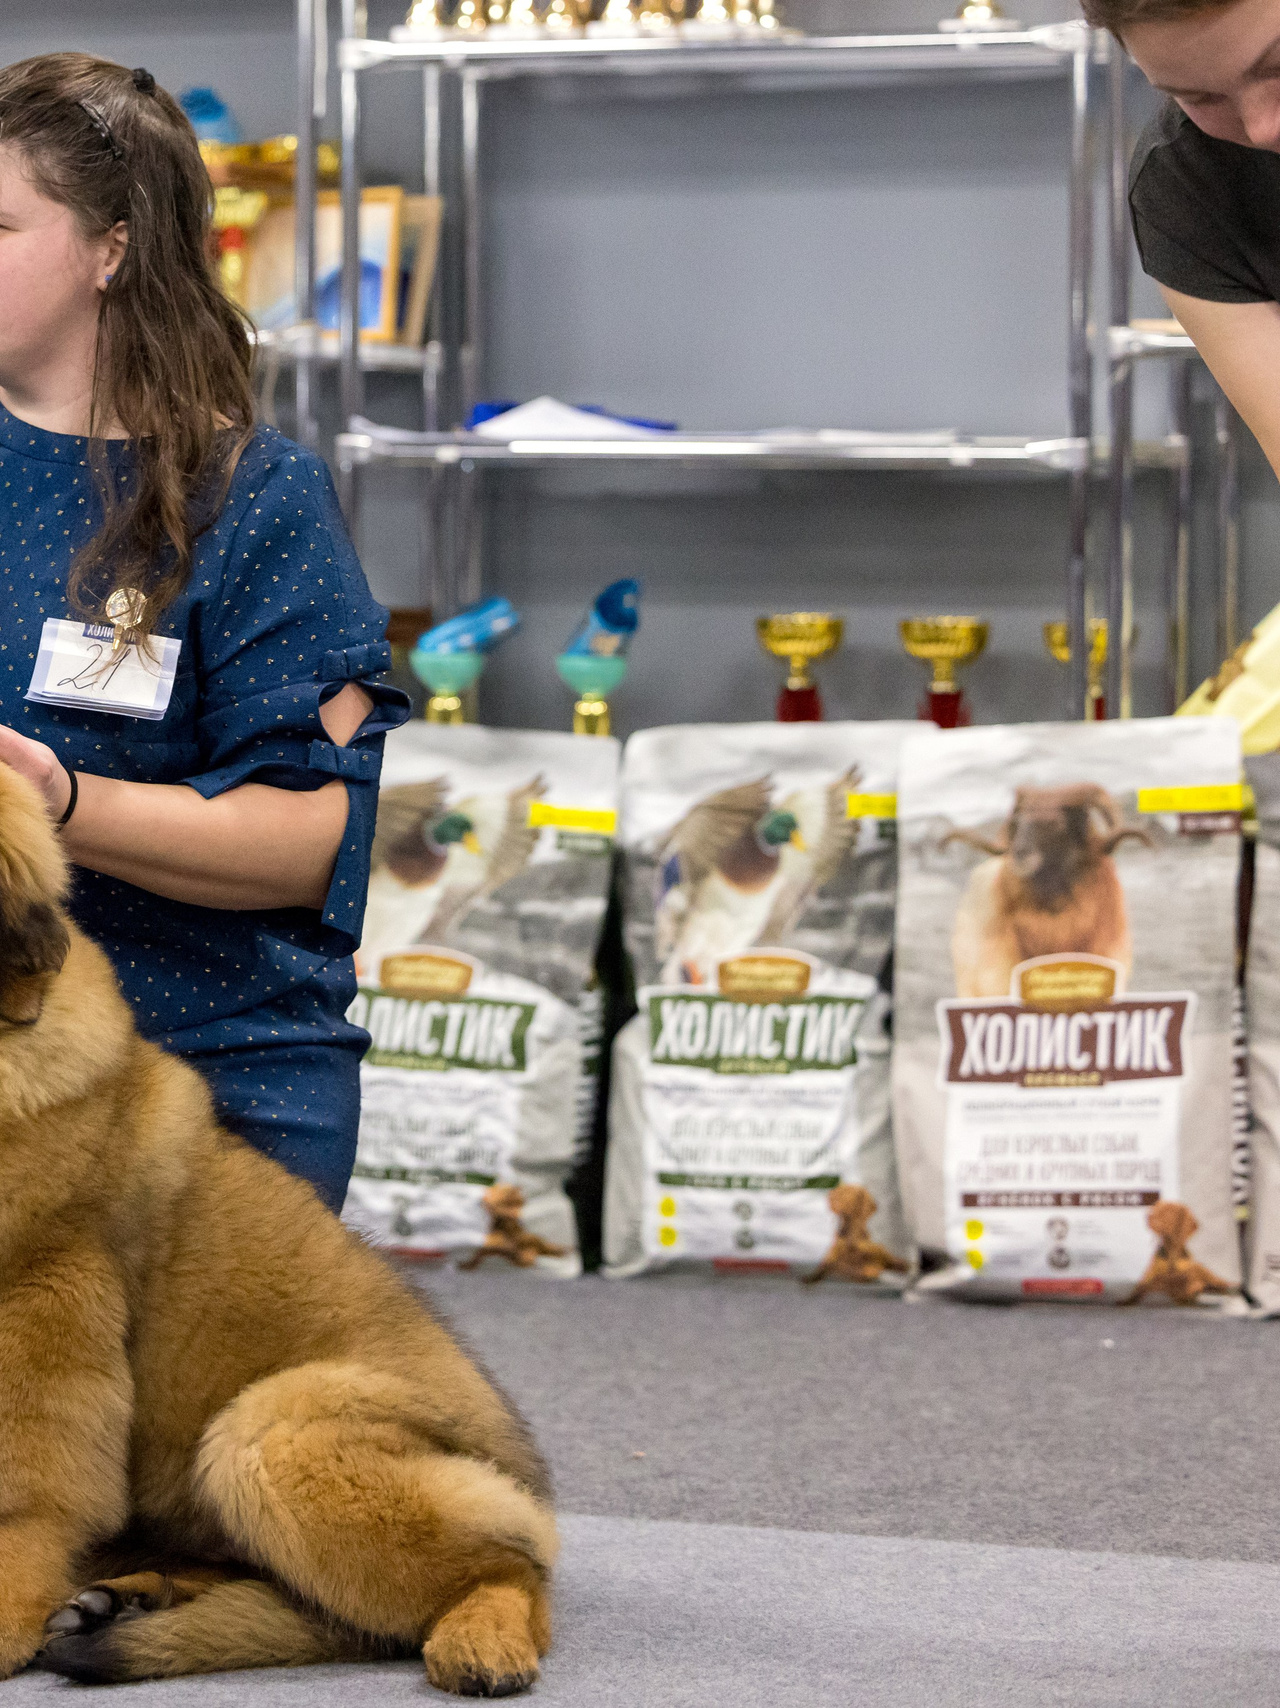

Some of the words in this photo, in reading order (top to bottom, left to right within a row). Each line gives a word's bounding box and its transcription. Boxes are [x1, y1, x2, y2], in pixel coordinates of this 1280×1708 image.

[350, 993, 524, 1067] ОЛИСТИК
[653, 1000, 862, 1065] ХОЛИСТИК
[959, 1007, 1174, 1078] ХОЛИСТИК
